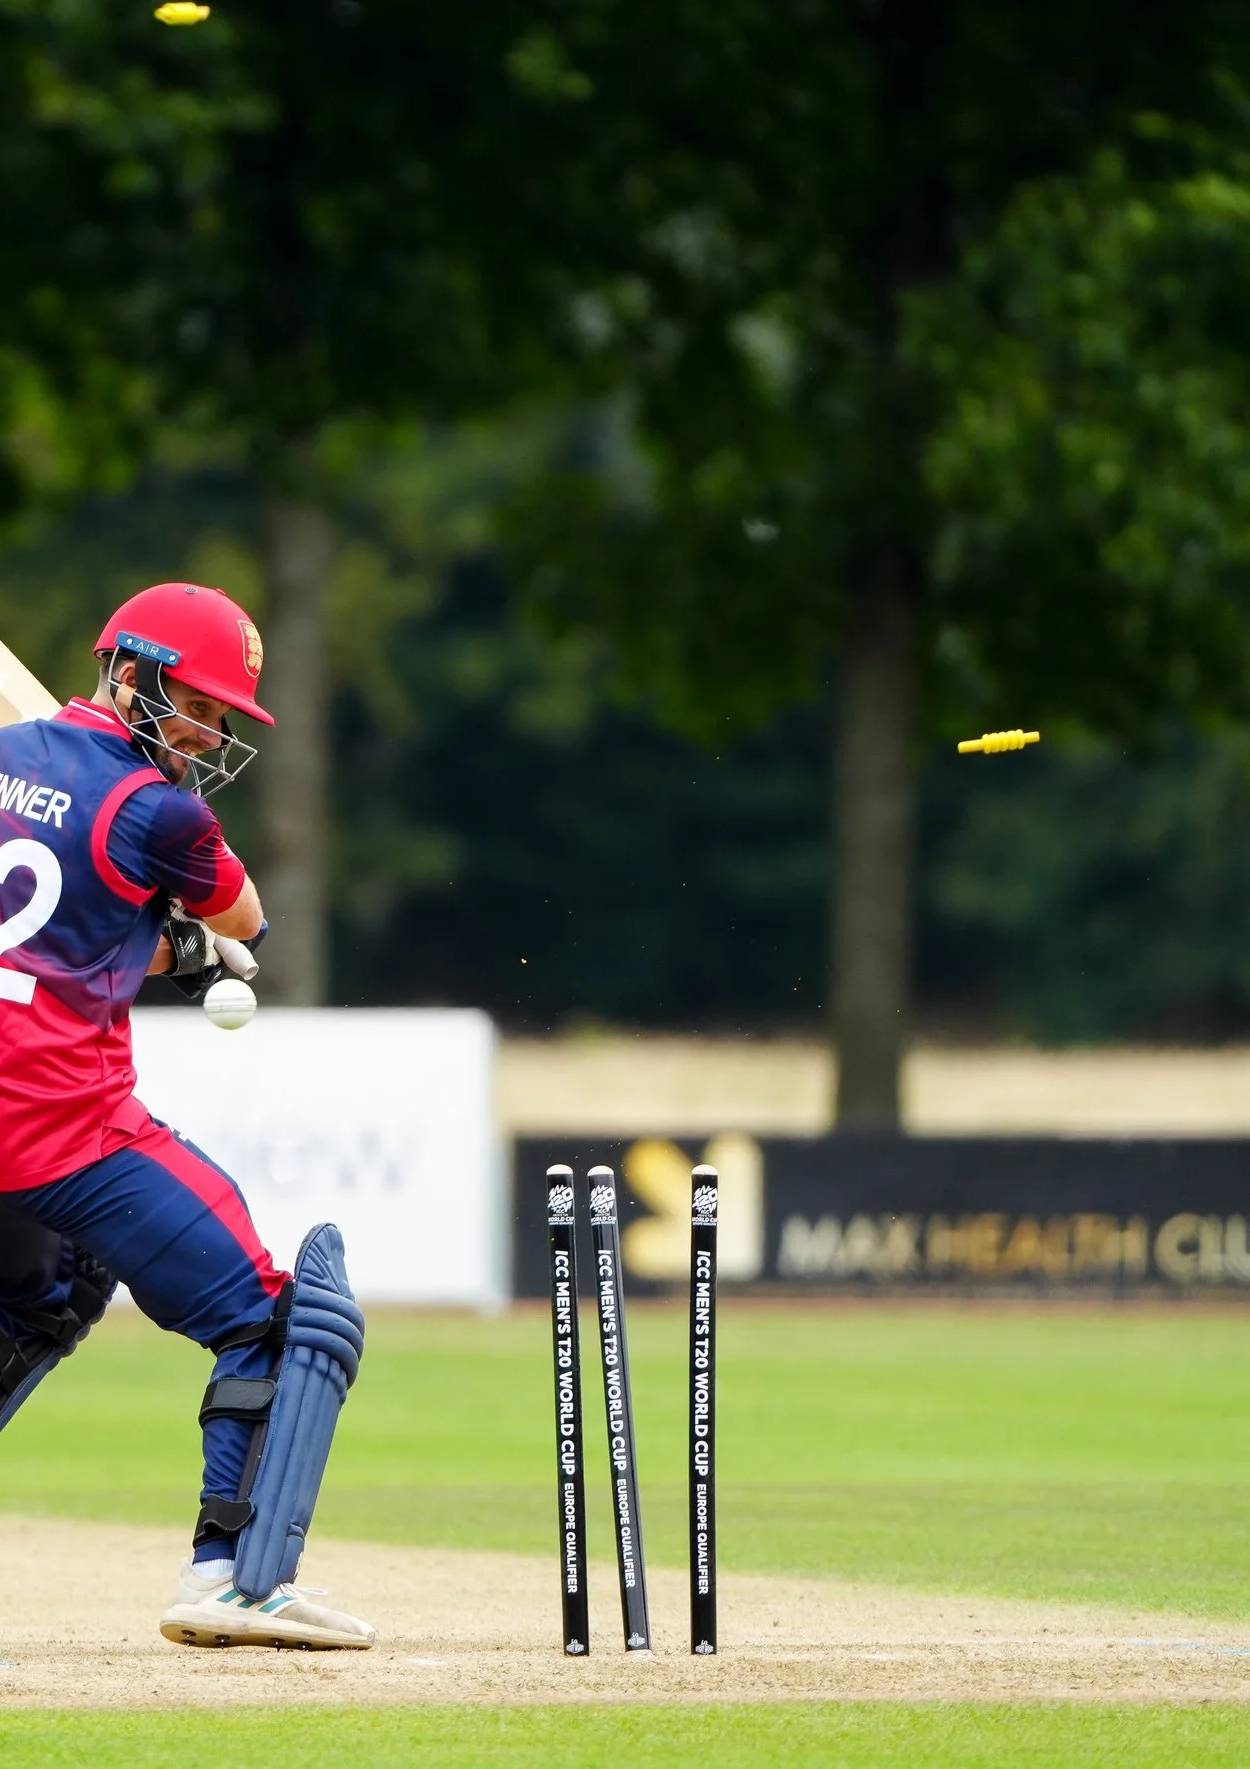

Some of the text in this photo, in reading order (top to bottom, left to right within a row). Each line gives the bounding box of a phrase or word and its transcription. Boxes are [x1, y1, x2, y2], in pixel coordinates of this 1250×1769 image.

[136, 641, 160, 656] AIR
[555, 1250, 578, 1594] ICC MEN'S T20 WORLD CUP EUROPE QUALIFIER
[598, 1249, 635, 1588] ICC MEN'S T20 WORLD CUP EUROPE QUALIFIER
[694, 1250, 711, 1595] ICC MEN'S T20 WORLD CUP EUROPE QUALIFIER
